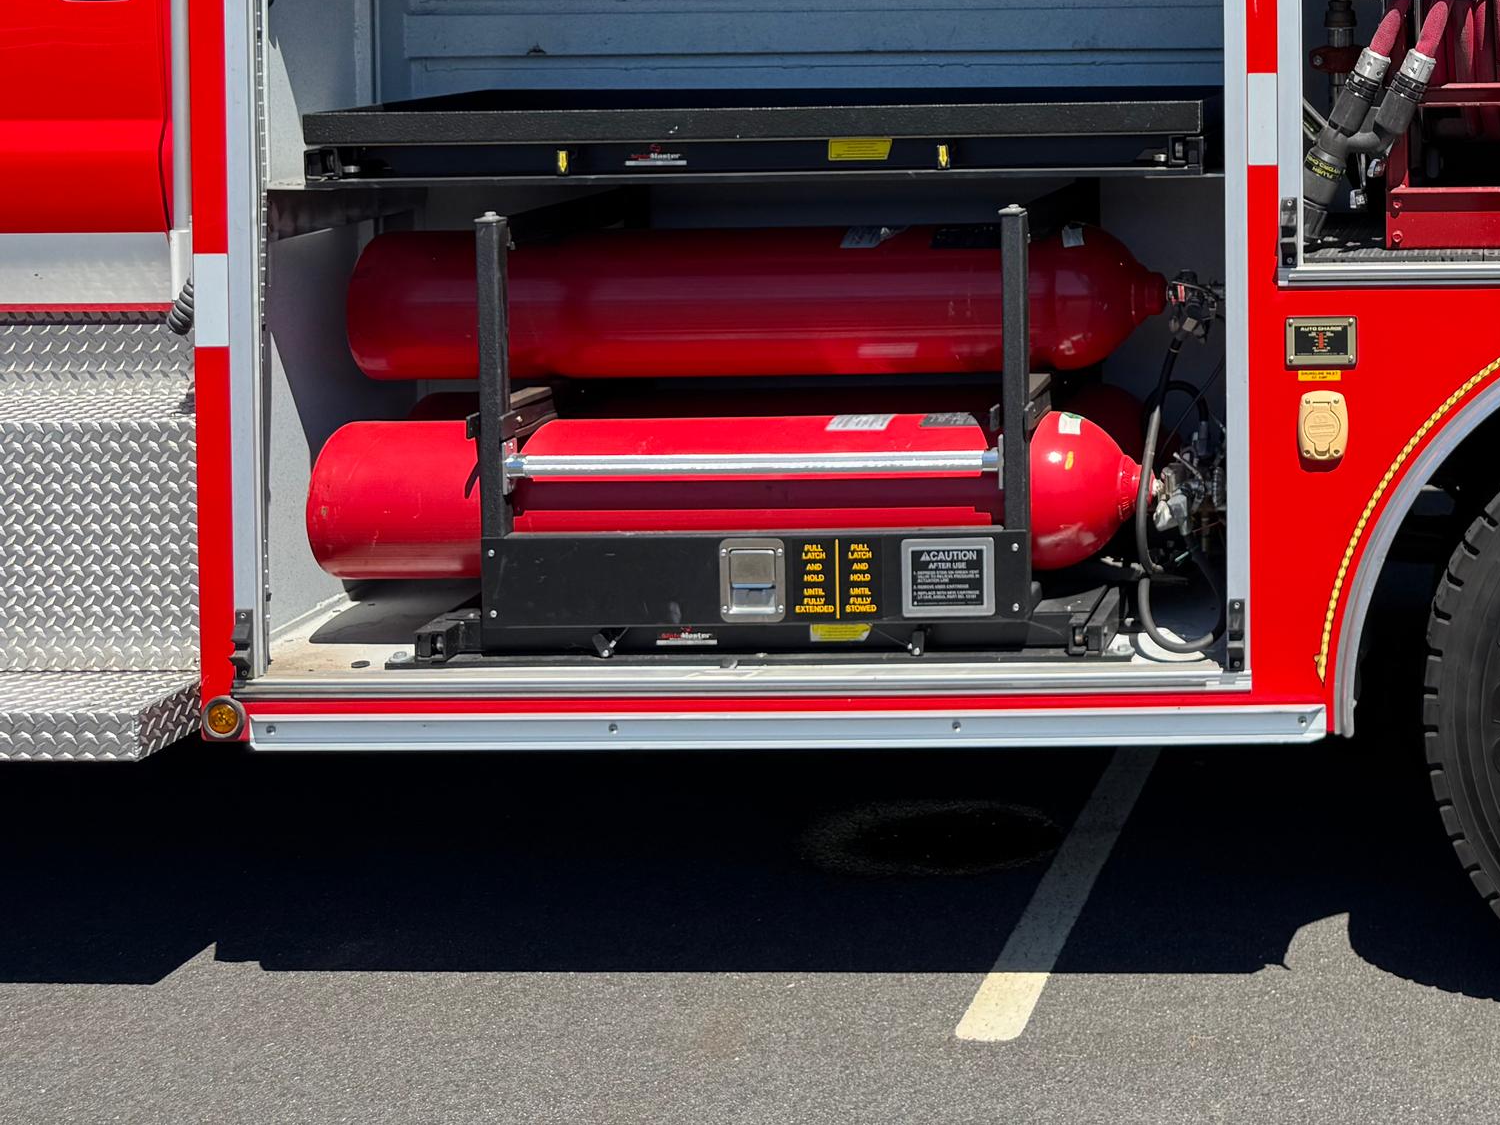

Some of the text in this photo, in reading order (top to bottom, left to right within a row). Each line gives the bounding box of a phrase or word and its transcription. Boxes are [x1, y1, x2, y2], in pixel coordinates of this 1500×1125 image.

[848, 551, 872, 559] LATCH
[930, 551, 976, 560] CAUTION
[804, 574, 825, 582] HOLD
[795, 605, 834, 613] EXTENDED
